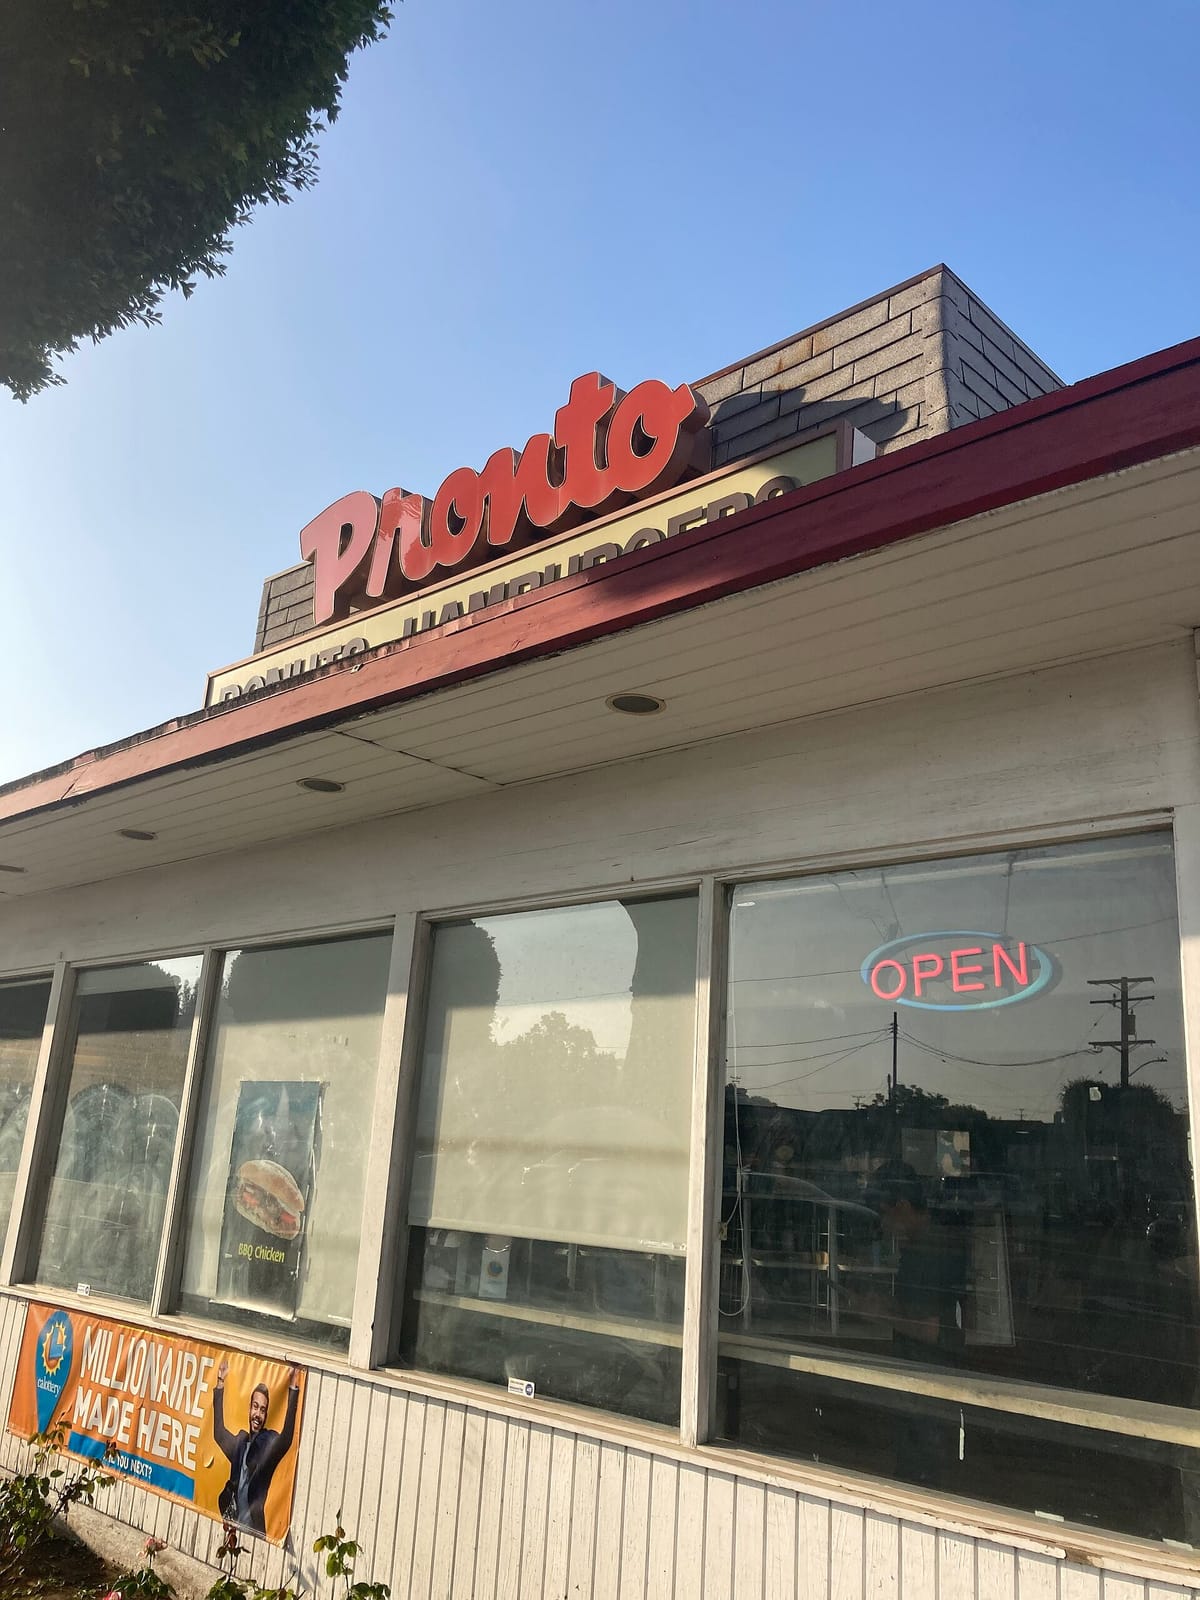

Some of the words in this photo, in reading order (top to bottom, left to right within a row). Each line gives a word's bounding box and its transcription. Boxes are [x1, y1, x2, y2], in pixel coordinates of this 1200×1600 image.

[300, 371, 696, 625] Pronto
[870, 941, 1029, 1000] OPEN
[238, 1243, 253, 1260] BBQ
[254, 1245, 285, 1263] Chicken
[80, 1325, 215, 1418] MILLIONAIRE
[73, 1385, 135, 1444] MADE
[136, 1409, 201, 1471] HERE
[117, 1455, 130, 1470] YOU
[130, 1460, 153, 1479] NEXT?
